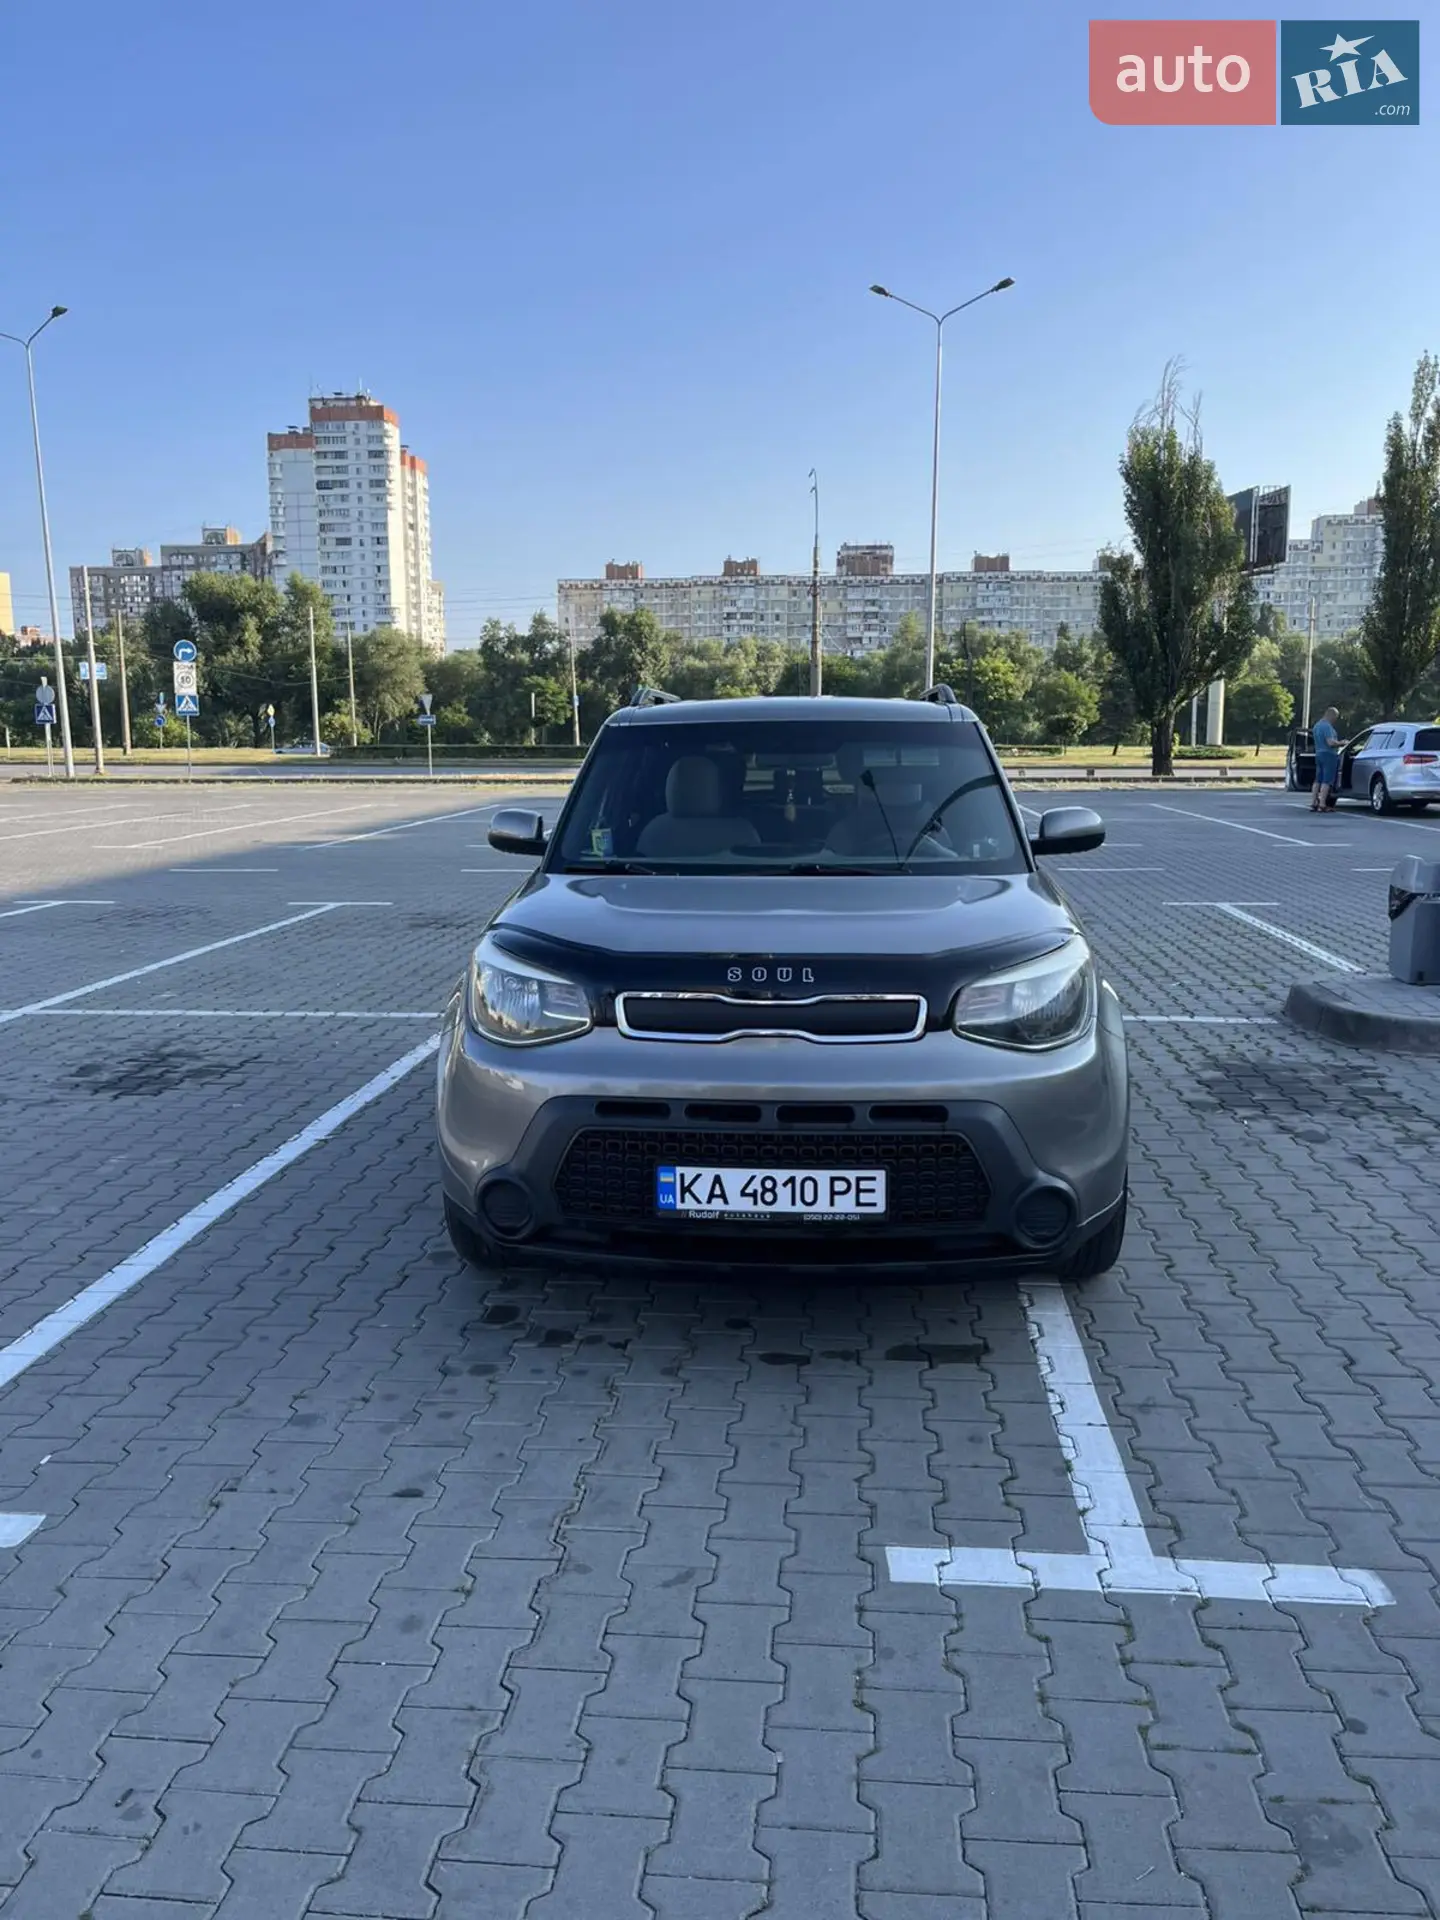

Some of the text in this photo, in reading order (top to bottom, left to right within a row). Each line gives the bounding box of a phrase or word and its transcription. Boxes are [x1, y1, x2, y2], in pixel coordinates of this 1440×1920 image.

[727, 966, 815, 983] SOUL
[679, 1172, 878, 1208] KA 4810 PE
[660, 1193, 674, 1204] UA
[689, 1210, 720, 1219] Rudolf
